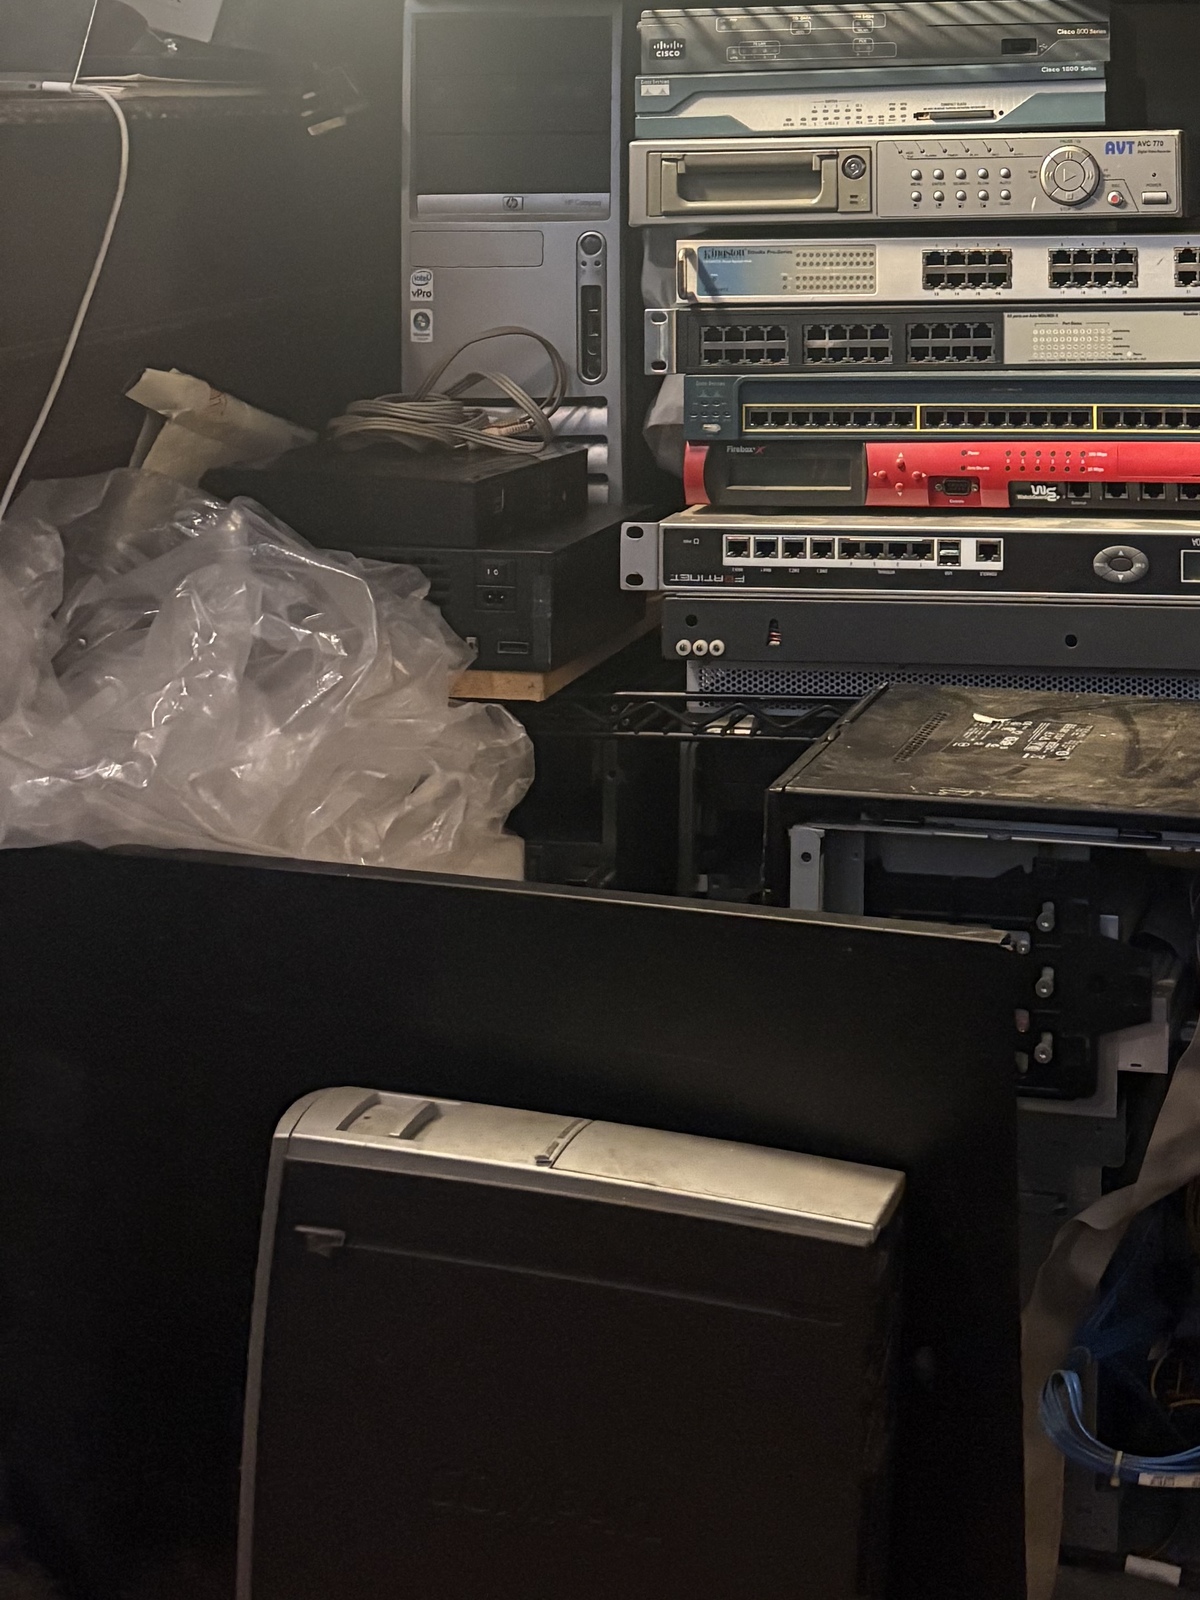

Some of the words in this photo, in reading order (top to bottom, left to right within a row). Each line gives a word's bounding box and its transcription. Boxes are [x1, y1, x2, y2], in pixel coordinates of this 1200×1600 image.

[656, 49, 681, 57] CISCO
[1105, 141, 1135, 155] AVT
[703, 249, 745, 259] Kingston
[413, 274, 430, 283] intel
[411, 289, 432, 299] vPro
[726, 445, 754, 453] Firebox
[669, 574, 745, 584] FORTINET
